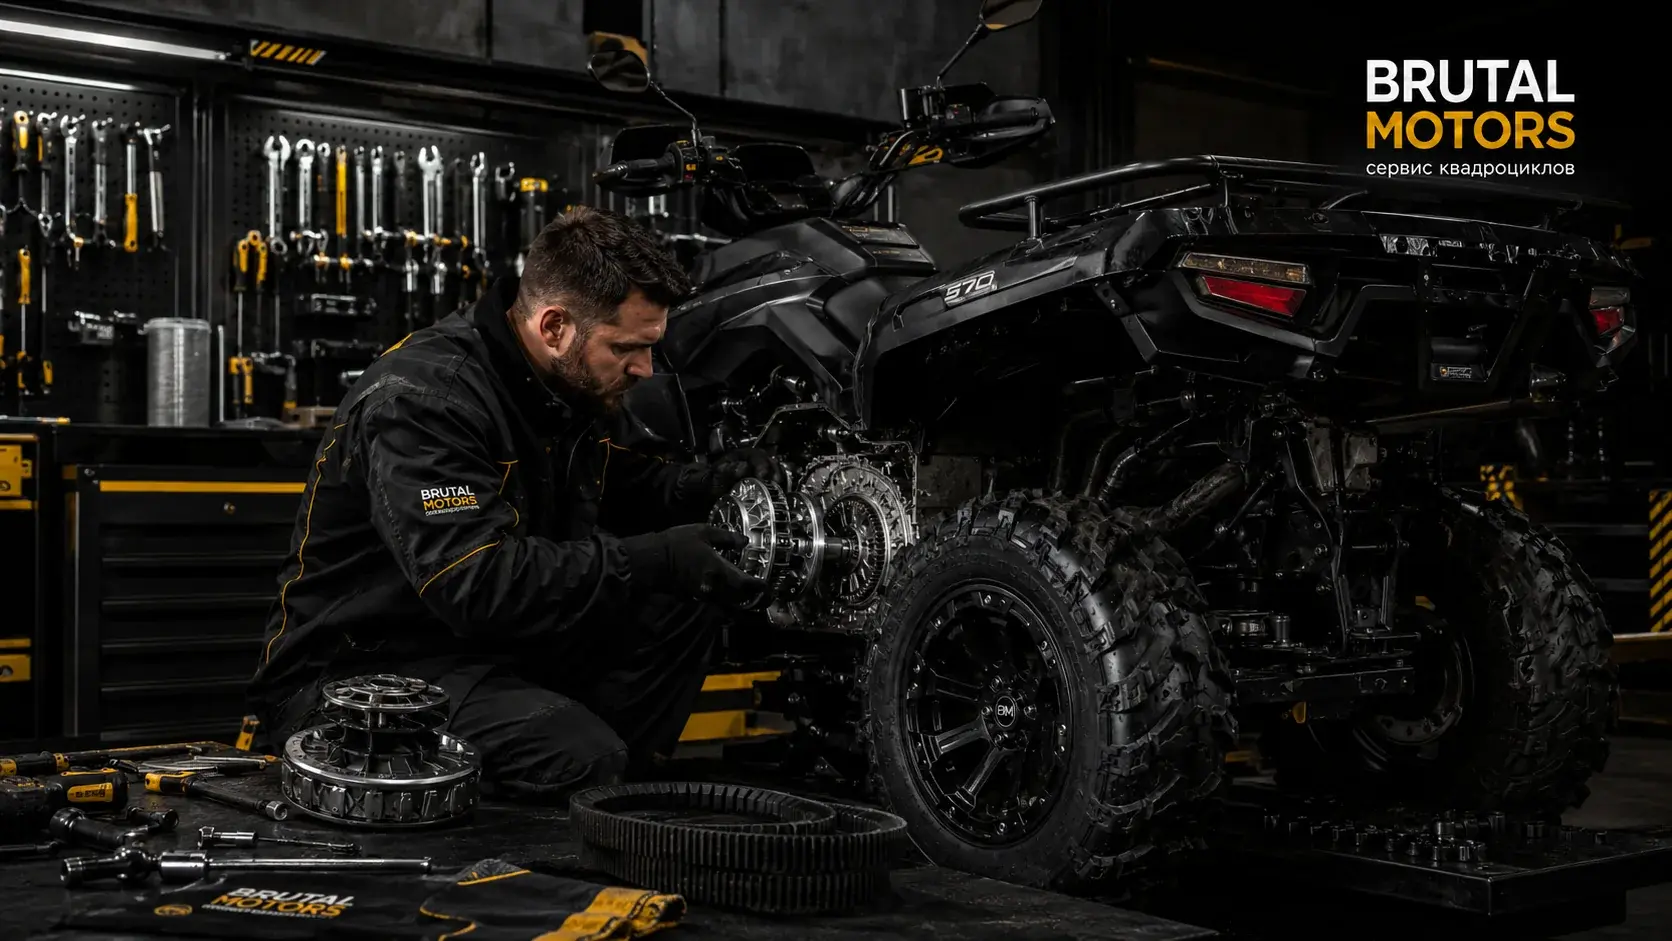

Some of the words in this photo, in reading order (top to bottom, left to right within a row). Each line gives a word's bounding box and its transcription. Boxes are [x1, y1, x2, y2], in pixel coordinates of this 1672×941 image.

[420, 485, 475, 500] BRUTAL
[423, 496, 478, 511] MOTORS
[997, 704, 1014, 717] BM
[229, 887, 355, 907] BRUTAL
[211, 894, 346, 917] MOTORS
